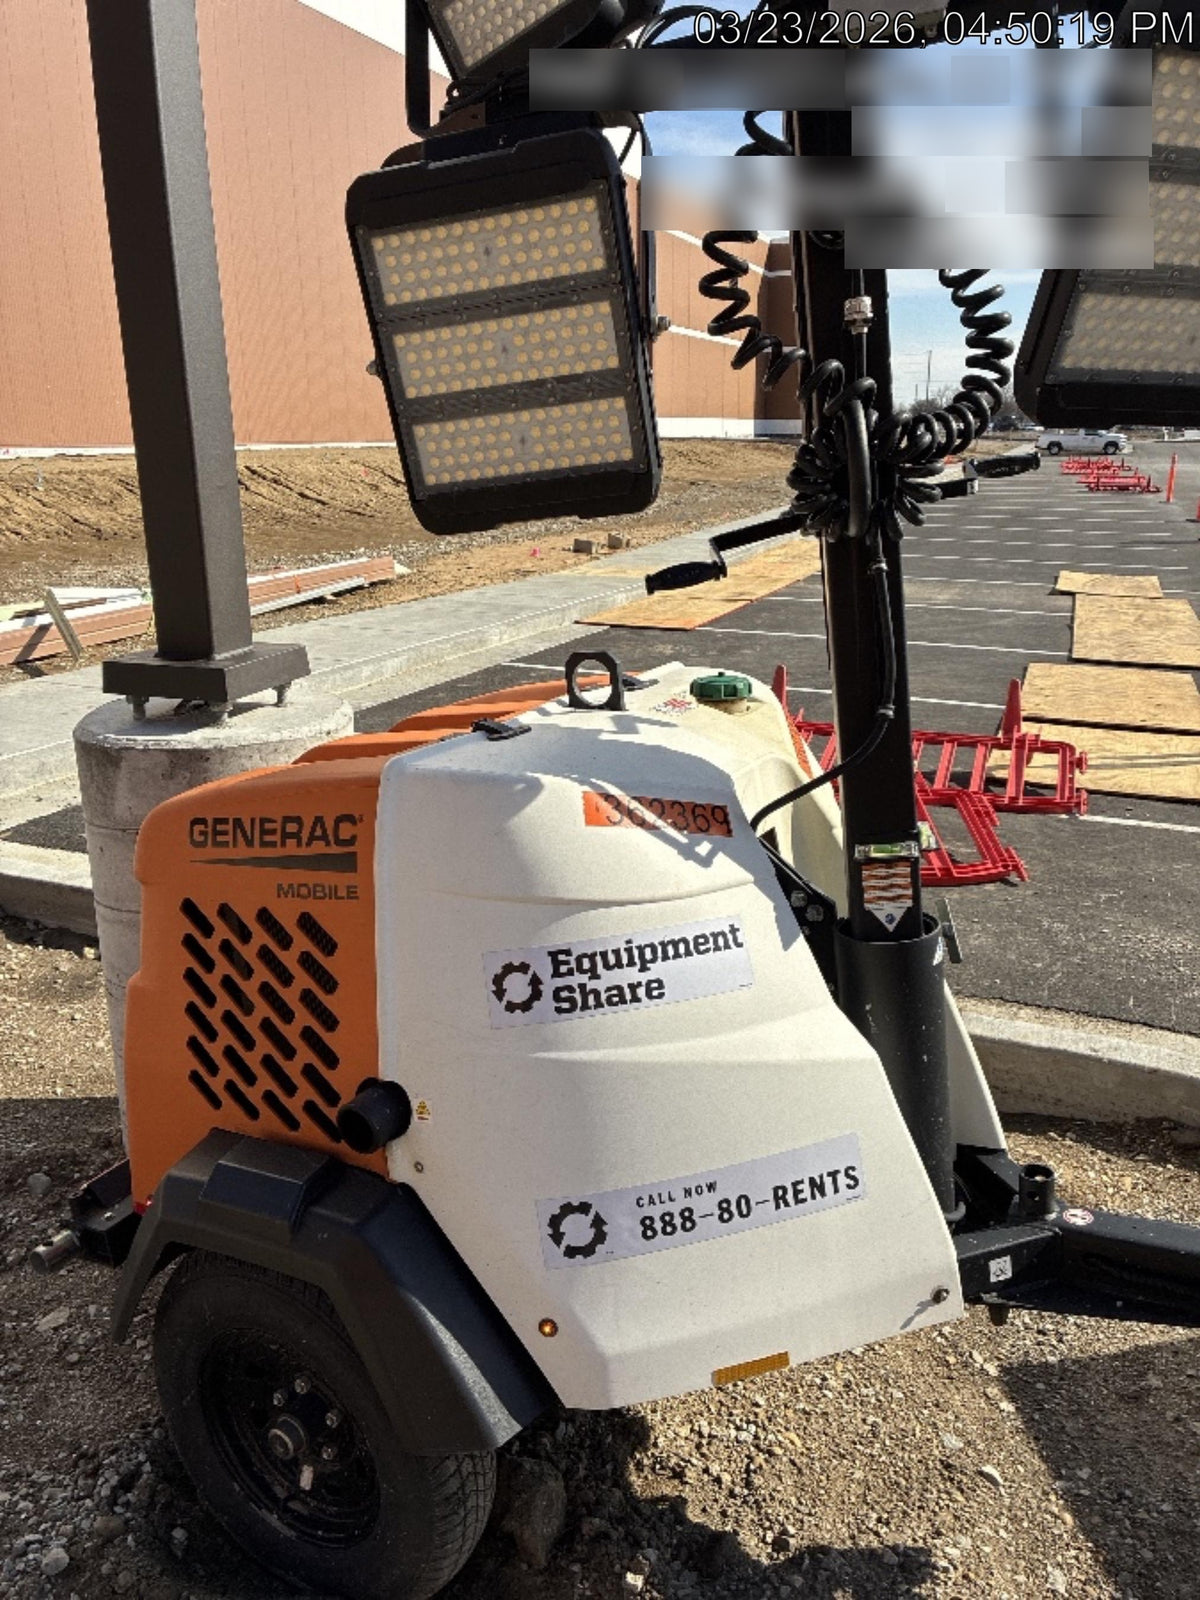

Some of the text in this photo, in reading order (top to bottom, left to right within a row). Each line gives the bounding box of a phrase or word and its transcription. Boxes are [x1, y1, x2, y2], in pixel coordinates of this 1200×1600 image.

[189, 814, 358, 849] GENERAC
[276, 883, 359, 901] MOBILE
[548, 924, 744, 980] Equipment
[553, 977, 666, 1016] Share
[636, 1181, 718, 1208] CALL NOW
[640, 1166, 860, 1241] 888-80-RENTS
